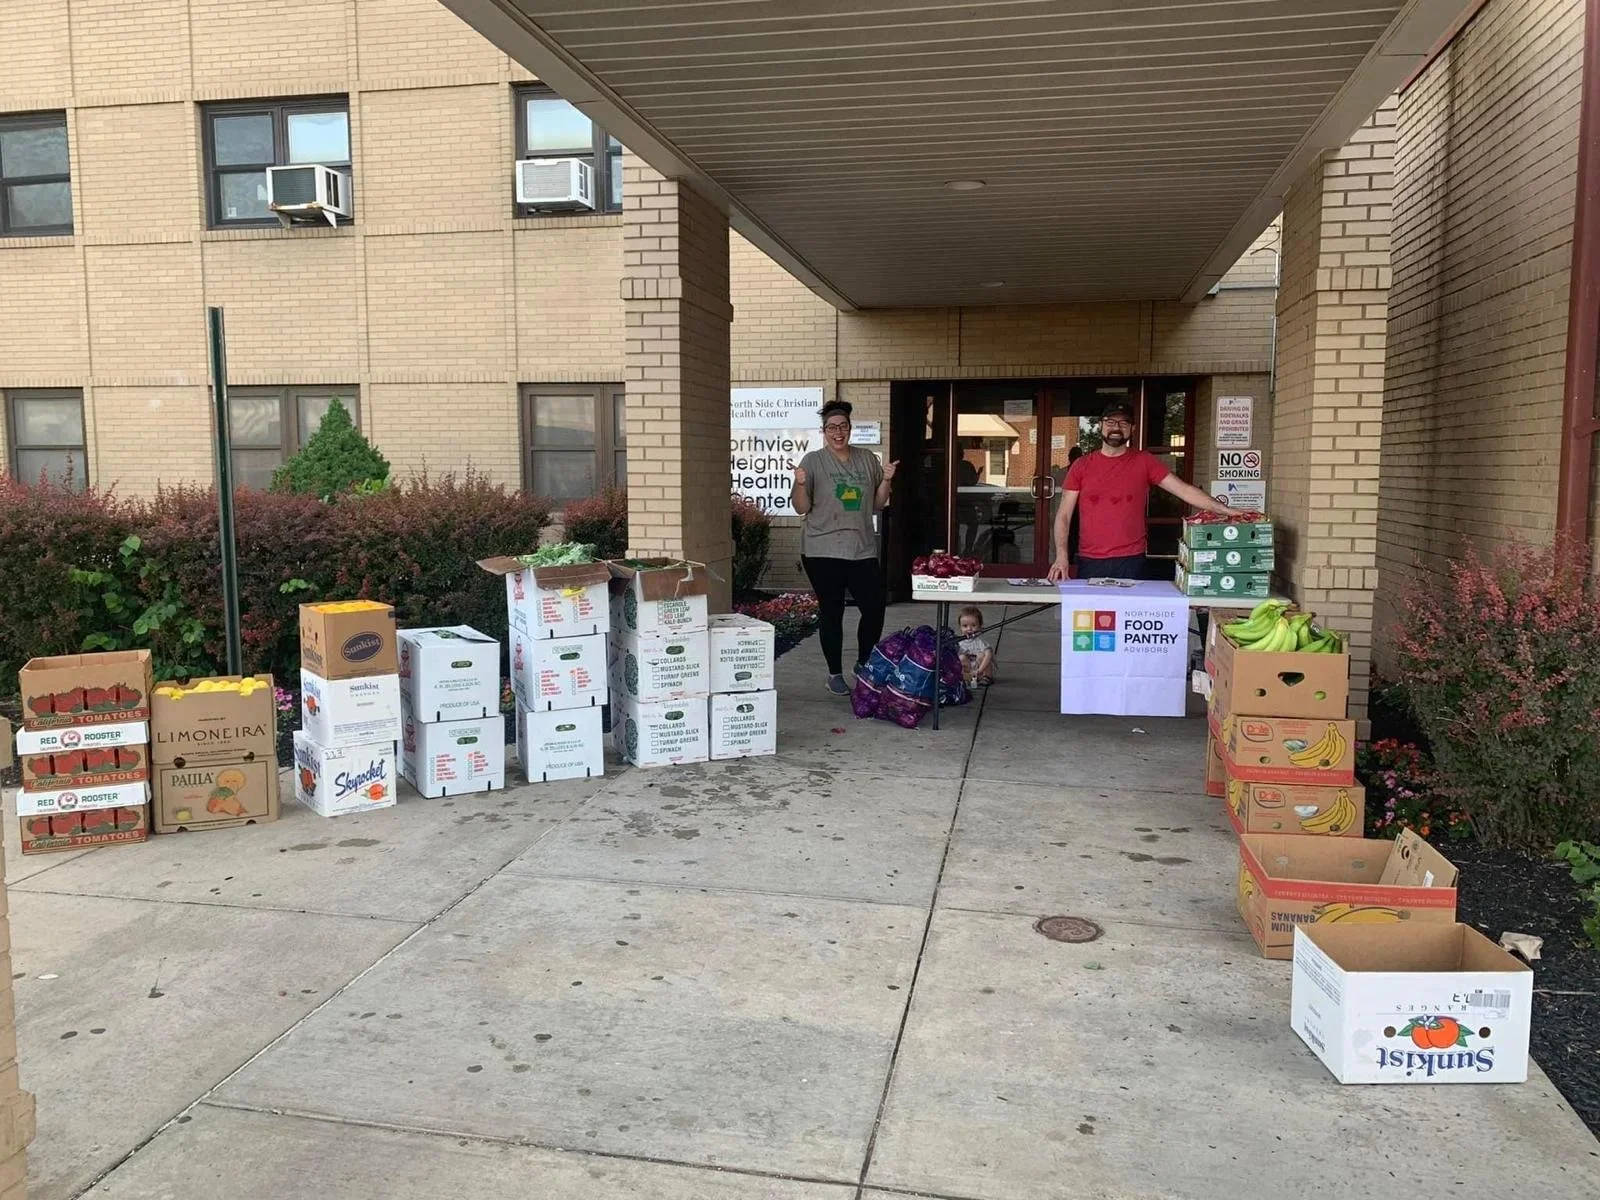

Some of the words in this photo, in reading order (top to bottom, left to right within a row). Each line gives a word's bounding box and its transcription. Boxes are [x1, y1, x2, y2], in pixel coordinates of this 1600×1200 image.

[755, 399, 774, 408] Side
[777, 398, 818, 407] Christian
[759, 410, 789, 418] Center
[731, 436, 809, 452] orthview
[1220, 453, 1241, 466] NO
[1220, 470, 1259, 478] SMOKING
[731, 473, 791, 489] Health
[1125, 620, 1163, 630] FOOD
[1125, 634, 1178, 644] PANTRY
[344, 638, 380, 656] Sunkist
[349, 682, 379, 692] Sunkist
[79, 710, 142, 723] TOMATOES
[40, 737, 57, 745] RED
[84, 731, 121, 740] ROOSTER
[157, 725, 265, 743] LIMONEIRA
[79, 771, 141, 784] TOMATOES
[171, 773, 212, 787] PAULA
[334, 758, 387, 797] Skyrocket
[38, 799, 54, 807] RED
[81, 792, 118, 802] ROOSTER
[77, 830, 140, 844] TOMATOES
[1271, 912, 1316, 923] BANANAS
[1271, 923, 1295, 932] MIUM
[1376, 1047, 1495, 1077] Sunkist
